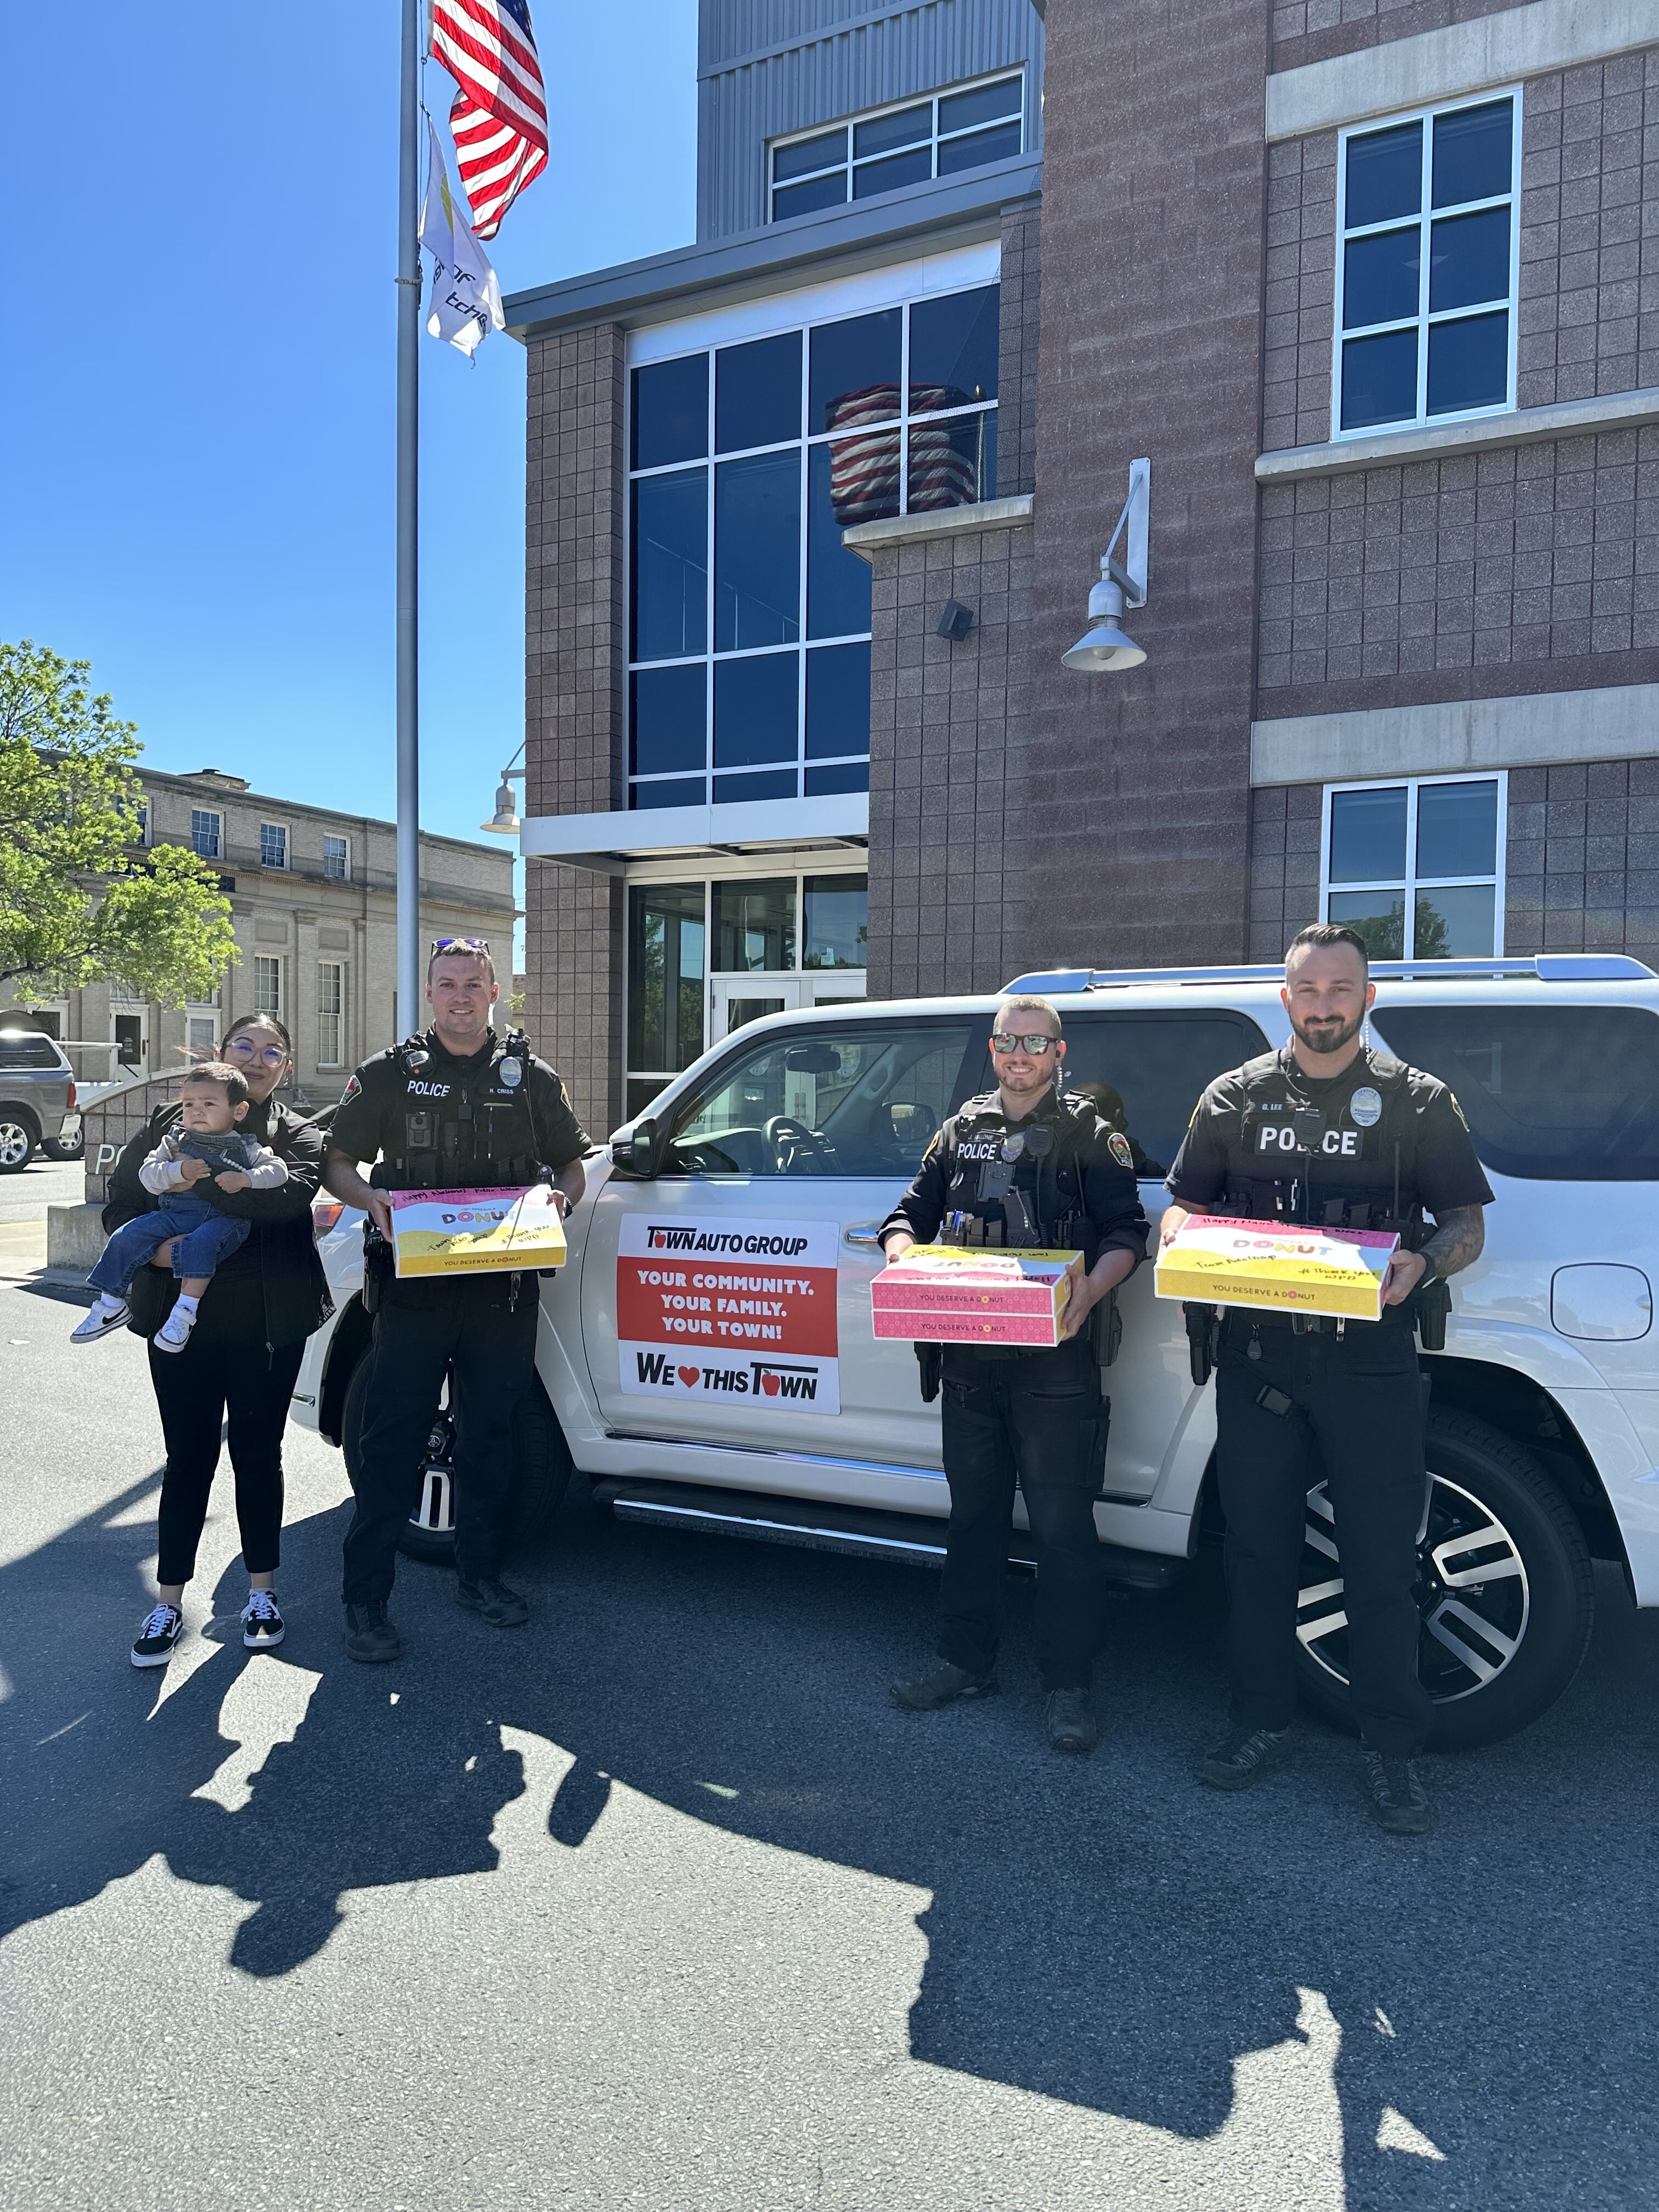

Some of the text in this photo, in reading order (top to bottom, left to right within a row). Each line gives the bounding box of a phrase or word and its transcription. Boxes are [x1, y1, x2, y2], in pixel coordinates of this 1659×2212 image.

[407, 1080, 450, 1097] POLICE
[1260, 1127, 1357, 1155] POCE
[957, 1143, 996, 1160] POLICE
[442, 1211, 516, 1224] DONUT
[647, 1226, 808, 1255] TOWN AUTO GROUP
[1233, 1239, 1333, 1255] DONUT
[637, 1270, 814, 1296] YOUR COMMUNITY.
[977, 1295, 1004, 1304] DONUT
[1233, 1286, 1271, 1296] DESERVE
[1282, 1291, 1315, 1300] DONUT
[661, 1294, 787, 1317] YOUR FAMILY.
[662, 1317, 782, 1340] YOUR TOWN!
[979, 1324, 1006, 1333] DONUT
[702, 1368, 749, 1393] THIS
